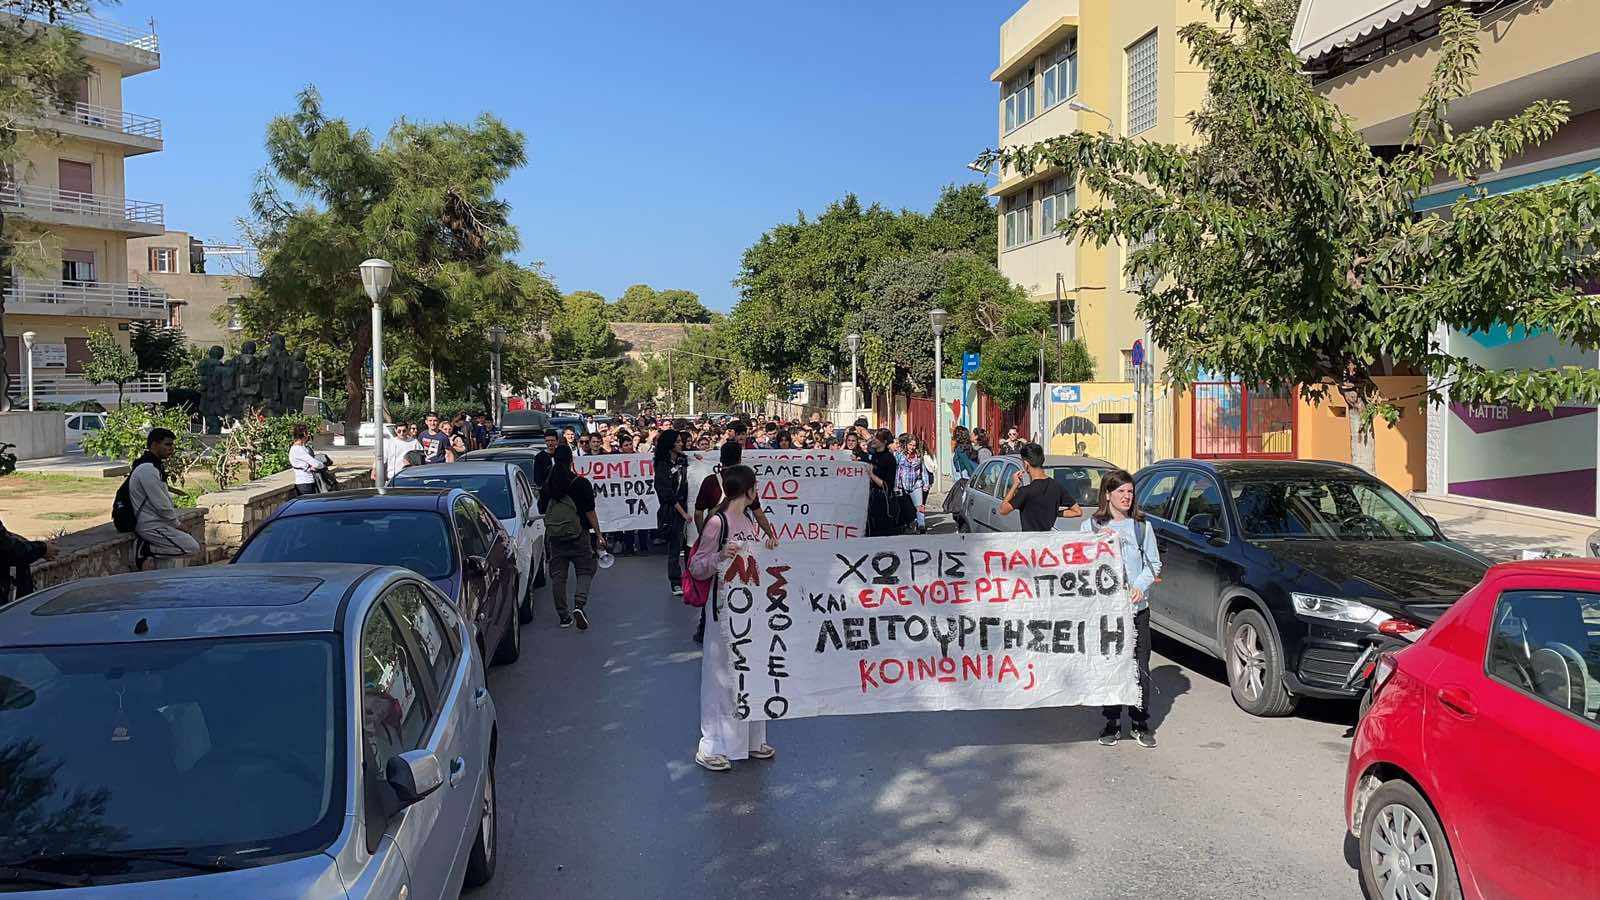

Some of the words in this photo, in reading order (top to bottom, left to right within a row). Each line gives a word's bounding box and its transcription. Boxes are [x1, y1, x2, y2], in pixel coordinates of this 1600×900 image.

[1469, 403, 1509, 420] MATTER
[755, 479, 799, 500] ΔΩ
[835, 549, 967, 584] ΧΩΡΙΣ
[764, 565, 793, 720] ΣΧΟΛΕΙΟ
[814, 614, 1086, 657] ΛΕΙΤΟΥΡΓΗΣΕΙ
